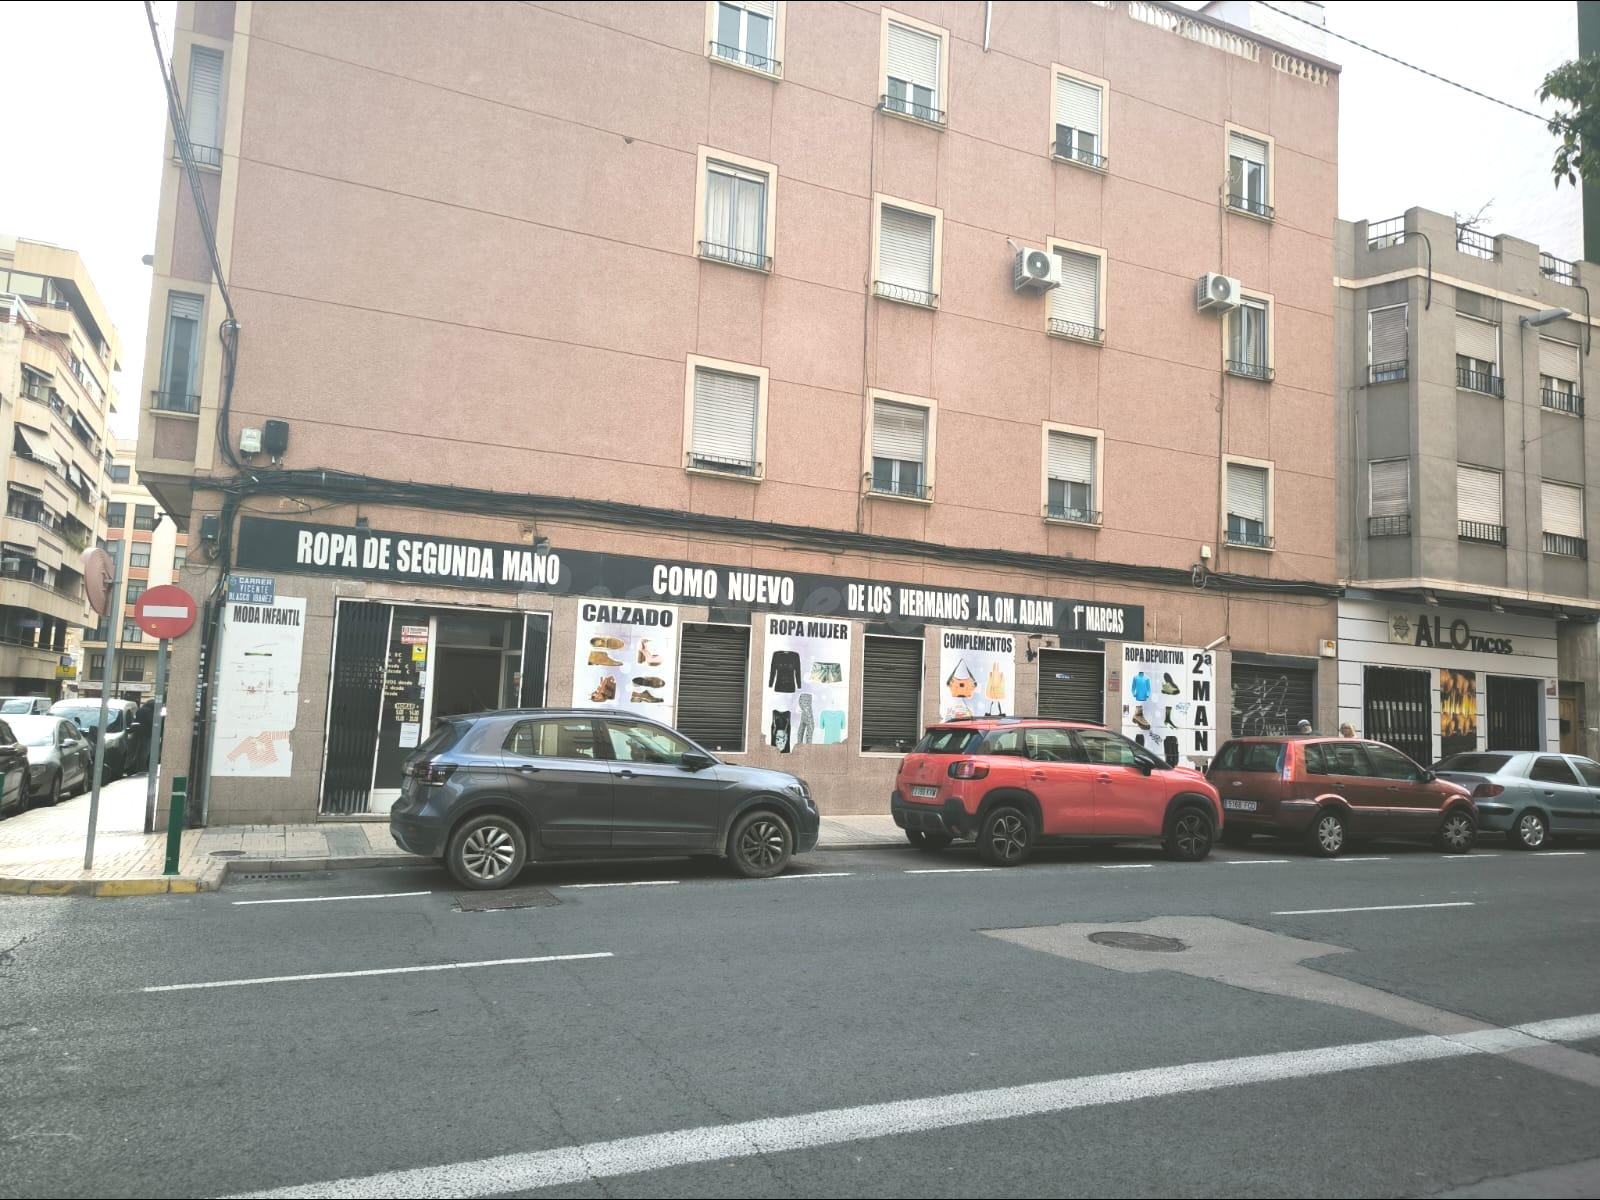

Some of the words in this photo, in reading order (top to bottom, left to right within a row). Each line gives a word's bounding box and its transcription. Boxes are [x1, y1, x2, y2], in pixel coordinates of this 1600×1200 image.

[297, 530, 357, 567] ROPA
[363, 537, 391, 570] DE
[396, 540, 494, 579] SEGUNDA
[502, 550, 560, 585] MANO
[239, 577, 272, 585] CARRER
[240, 584, 269, 594] VICENTE
[652, 564, 718, 599] COMO
[728, 572, 795, 606] NUEVO
[233, 605, 260, 624] MODA
[261, 607, 300, 626] INFANTIL
[582, 603, 673, 627] CALZADO
[848, 584, 865, 611] DE
[867, 585, 892, 614] LOS
[899, 588, 969, 620] HERMANOS
[1019, 599, 1054, 627] ADAM
[769, 618, 804, 637] ROPA
[807, 621, 848, 640] MUJER
[1086, 606, 1124, 634] MARCAS
[944, 632, 1012, 653] COMPLEMENTOS
[1415, 615, 1470, 650] ALO
[1470, 636, 1513, 654] TACOS
[1125, 647, 1145, 663] ROPA
[1145, 649, 1184, 665] DEPORTIVA
